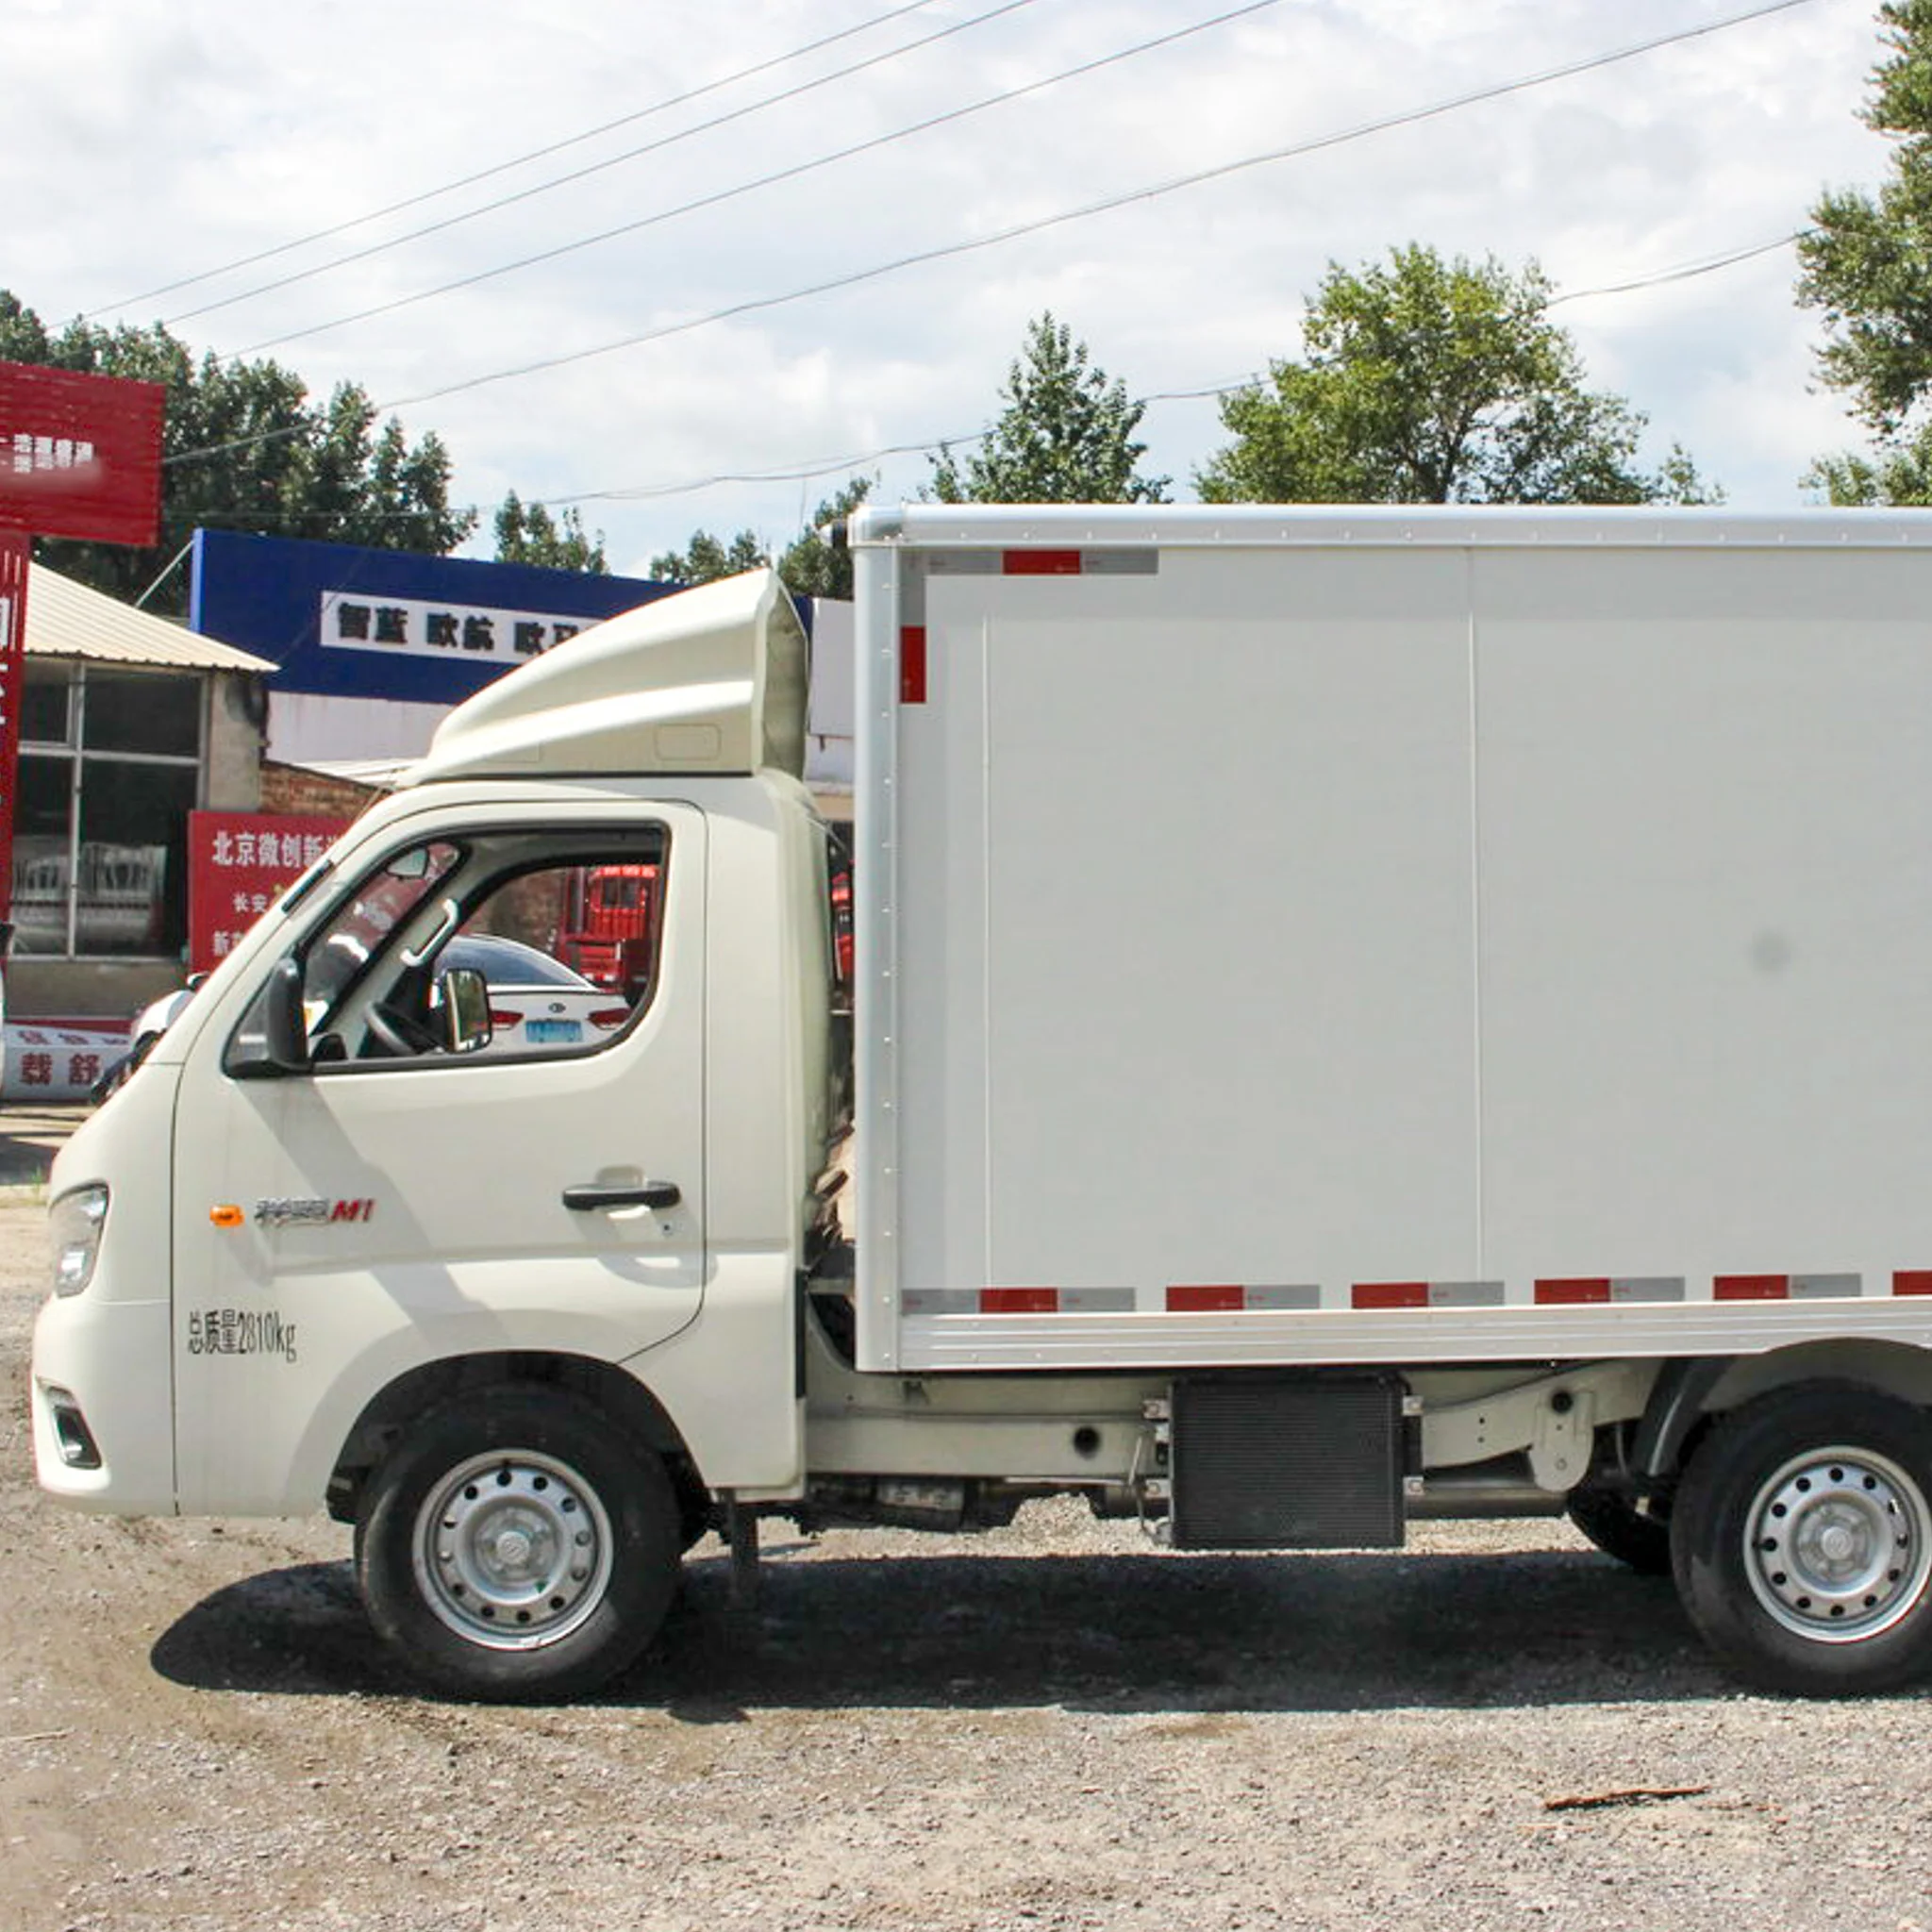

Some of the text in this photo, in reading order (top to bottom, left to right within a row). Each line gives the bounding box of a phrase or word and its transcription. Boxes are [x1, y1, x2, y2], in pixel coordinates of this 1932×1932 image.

[211, 830, 338, 868] 北京微创新
[188, 1308, 297, 1363] 总质量2810kg
